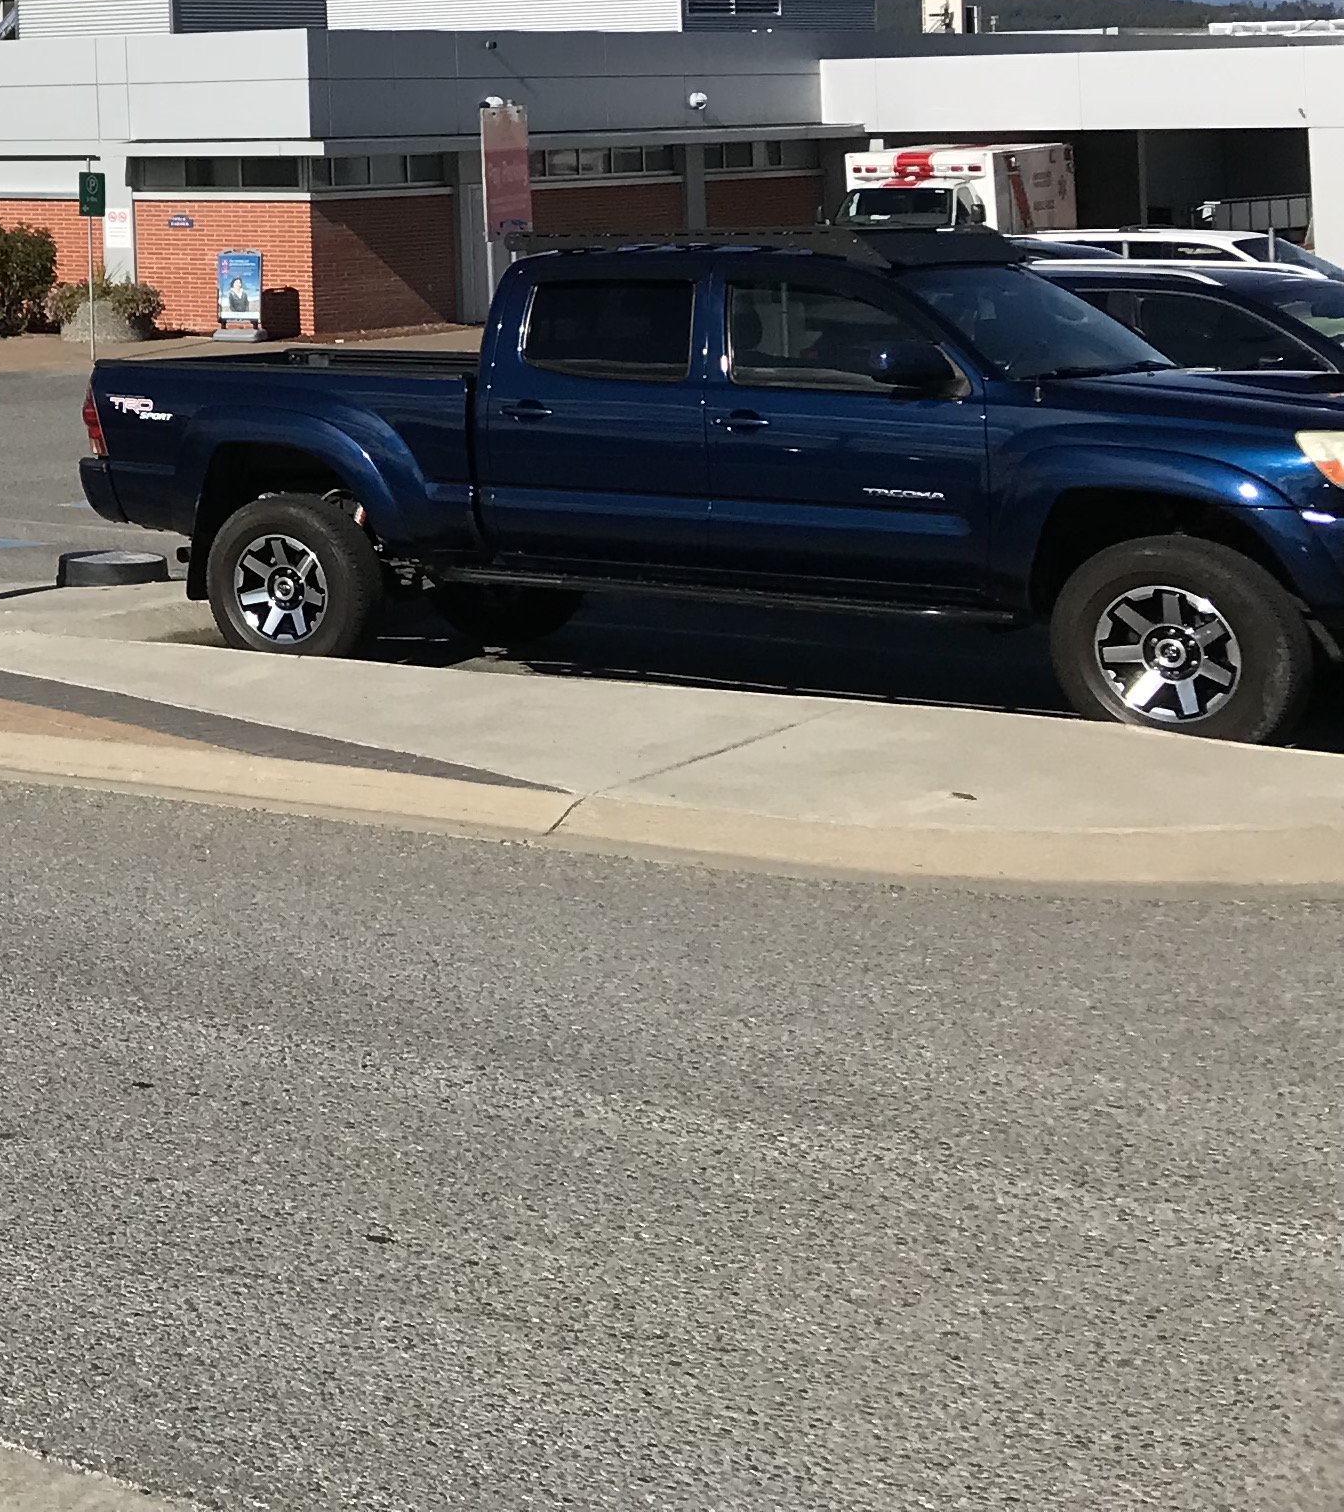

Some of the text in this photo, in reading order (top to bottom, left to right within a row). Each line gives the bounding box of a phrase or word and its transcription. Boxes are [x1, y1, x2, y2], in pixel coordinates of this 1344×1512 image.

[110, 396, 154, 414] TRD
[139, 412, 173, 421] SPORT
[863, 487, 945, 501] TACOMA
